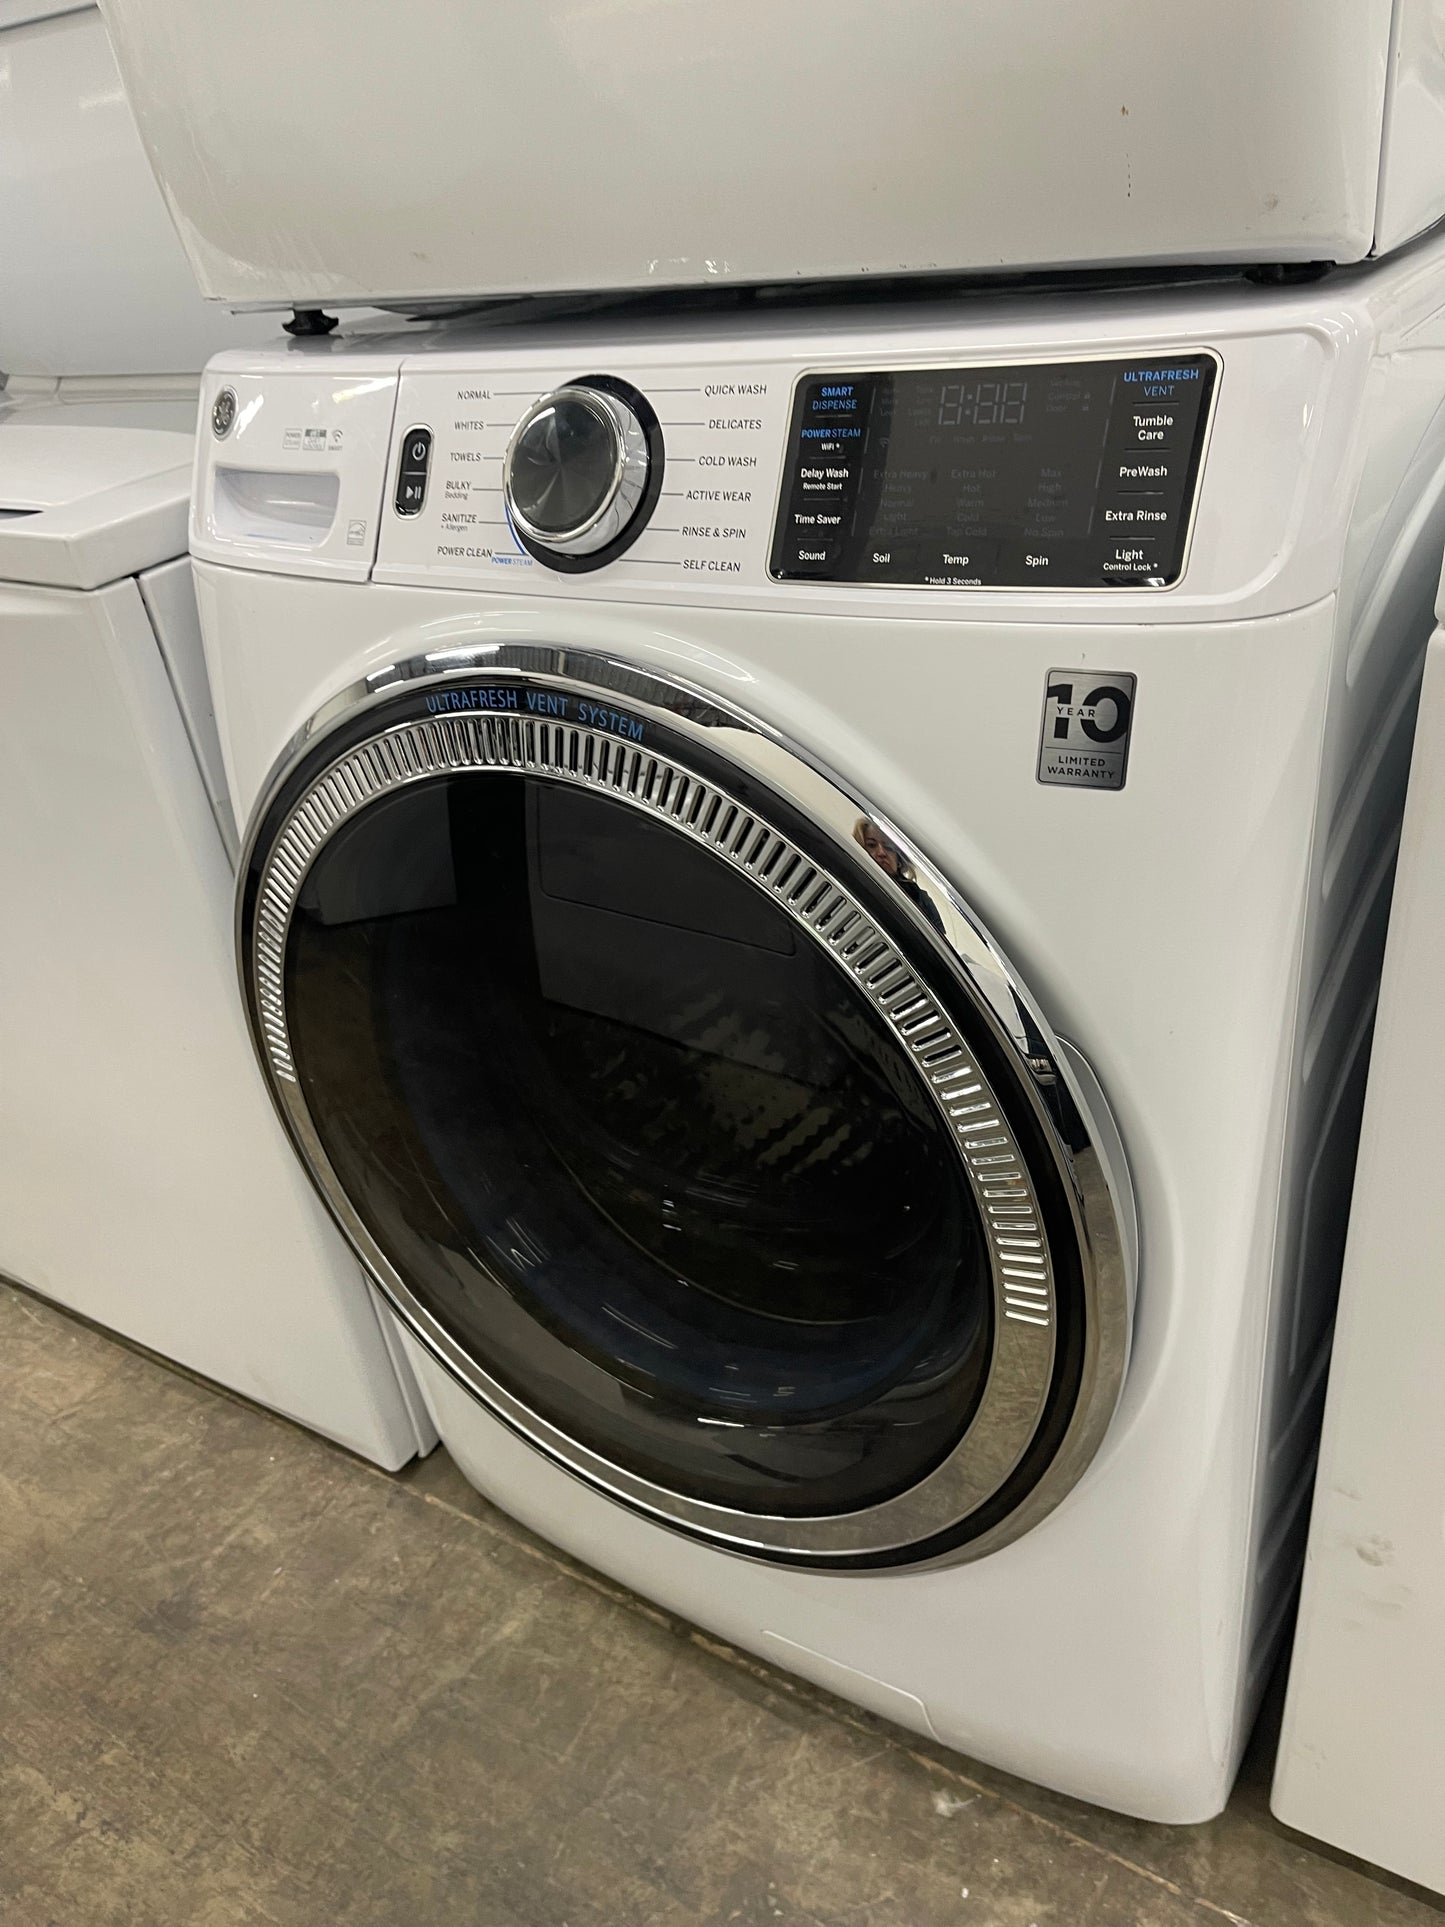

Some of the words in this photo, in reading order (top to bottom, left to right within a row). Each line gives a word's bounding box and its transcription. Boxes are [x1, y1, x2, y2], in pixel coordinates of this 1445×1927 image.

[1123, 369, 1199, 382] ULTRAFRESH
[457, 390, 492, 400] NORMAL
[704, 385, 736, 396] QUICK
[738, 384, 767, 395] WASH
[821, 386, 854, 397] SMART
[1143, 385, 1175, 397] VENT
[812, 400, 858, 410] DISPENSE
[454, 420, 485, 431] WHITES
[708, 419, 763, 430] DELICATES
[1133, 415, 1174, 427] Tumble
[801, 429, 861, 438] POWERSTEAM
[1138, 429, 1165, 441] Care
[450, 453, 481, 462] TOWELS
[698, 456, 725, 467] COLD
[726, 456, 757, 467] WASH
[800, 468, 825, 480] Delay
[826, 468, 850, 478] Wash
[1119, 466, 1168, 478] PreWash
[446, 481, 472, 491] BULKY
[803, 482, 826, 490] Remote
[827, 482, 843, 490] Start
[686, 490, 720, 501] ACTIVE
[723, 491, 752, 502] WEAR
[441, 513, 477, 523] SANITIZE
[794, 514, 815, 525] Time
[816, 514, 842, 525] Saver
[1105, 511, 1134, 521] Extra
[1136, 510, 1168, 521] Rinse
[682, 527, 711, 538] RINSE
[712, 528, 720, 538] &
[721, 527, 746, 539] SPIN
[437, 546, 465, 557] POWER
[466, 547, 493, 558] CLEAN
[798, 550, 826, 561] Sound
[872, 553, 890, 563] Soil
[1115, 549, 1144, 562] Light
[683, 560, 706, 571] SELF
[707, 560, 741, 572] CLEAN
[943, 554, 970, 567] Temp
[1025, 555, 1049, 568] Spin
[1103, 563, 1131, 572] Control
[1133, 563, 1152, 572] Lock
[929, 577, 946, 585] Hold
[952, 577, 982, 586] Seconds
[426, 690, 518, 713] ULTRAFRESH
[526, 691, 569, 716] VENT
[578, 703, 644, 742] SYSTEM
[1047, 684, 1131, 744] 10
[1057, 706, 1096, 718] YEAR
[1058, 755, 1106, 767] LIMITED
[1047, 766, 1115, 779] WARRANTY
